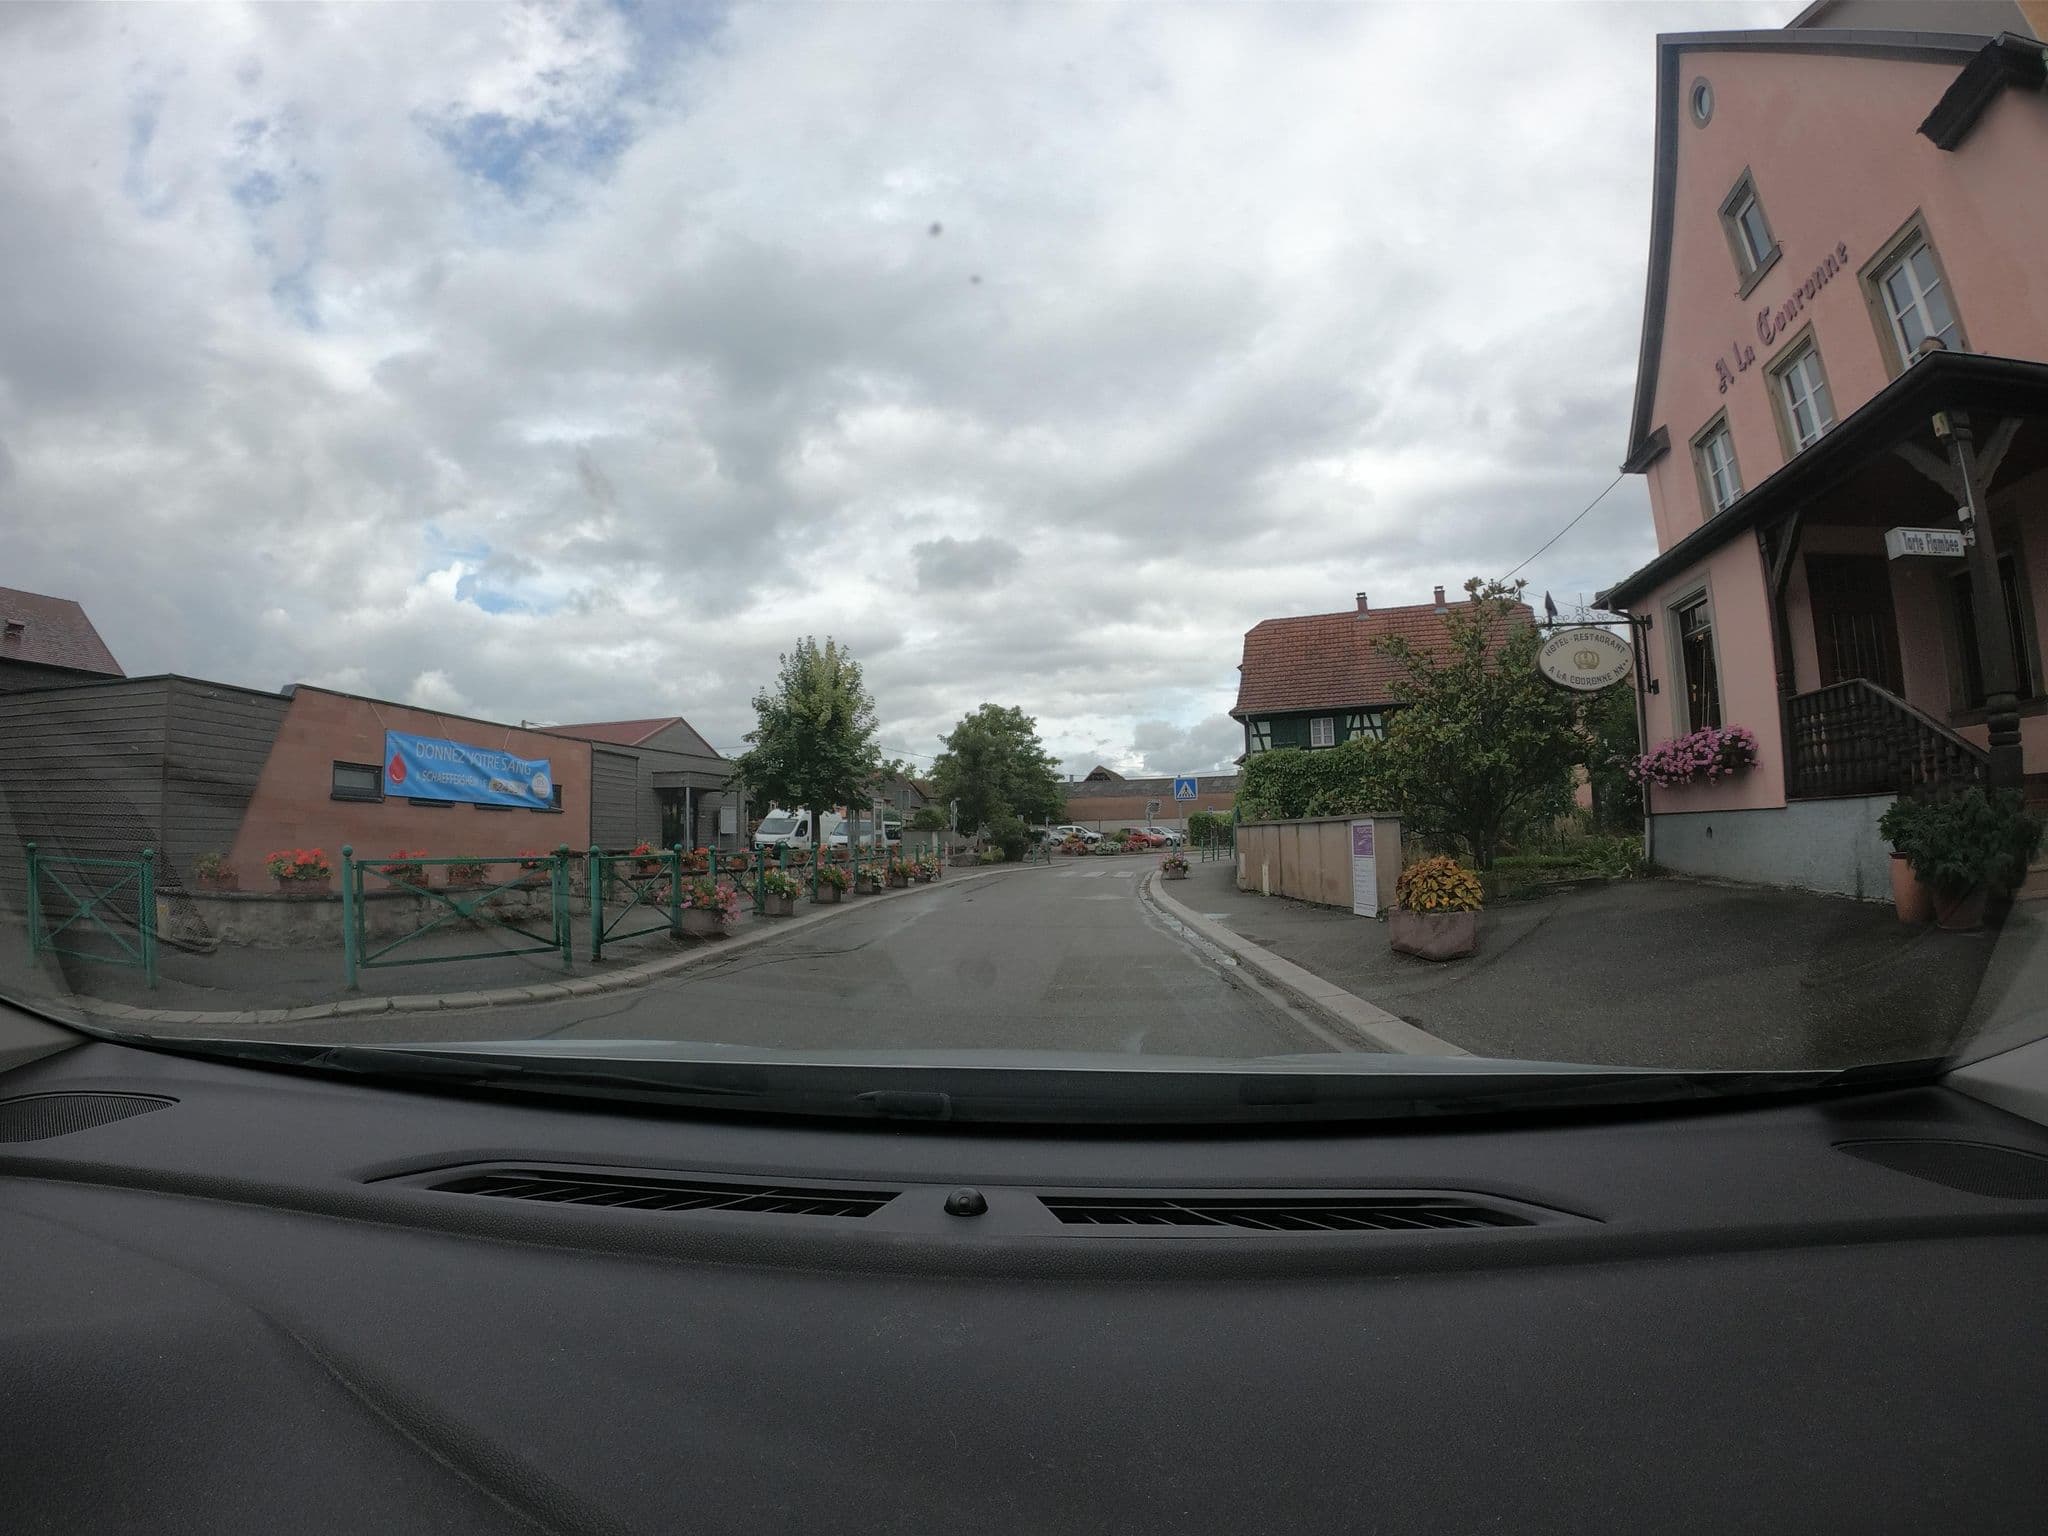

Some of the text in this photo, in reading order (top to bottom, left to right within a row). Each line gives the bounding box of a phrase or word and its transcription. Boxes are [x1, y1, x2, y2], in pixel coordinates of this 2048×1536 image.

[1715, 357, 1735, 394] A
[1756, 240, 1849, 346] Couronne
[416, 742, 532, 776] DONNEZ VOTRE SANG
